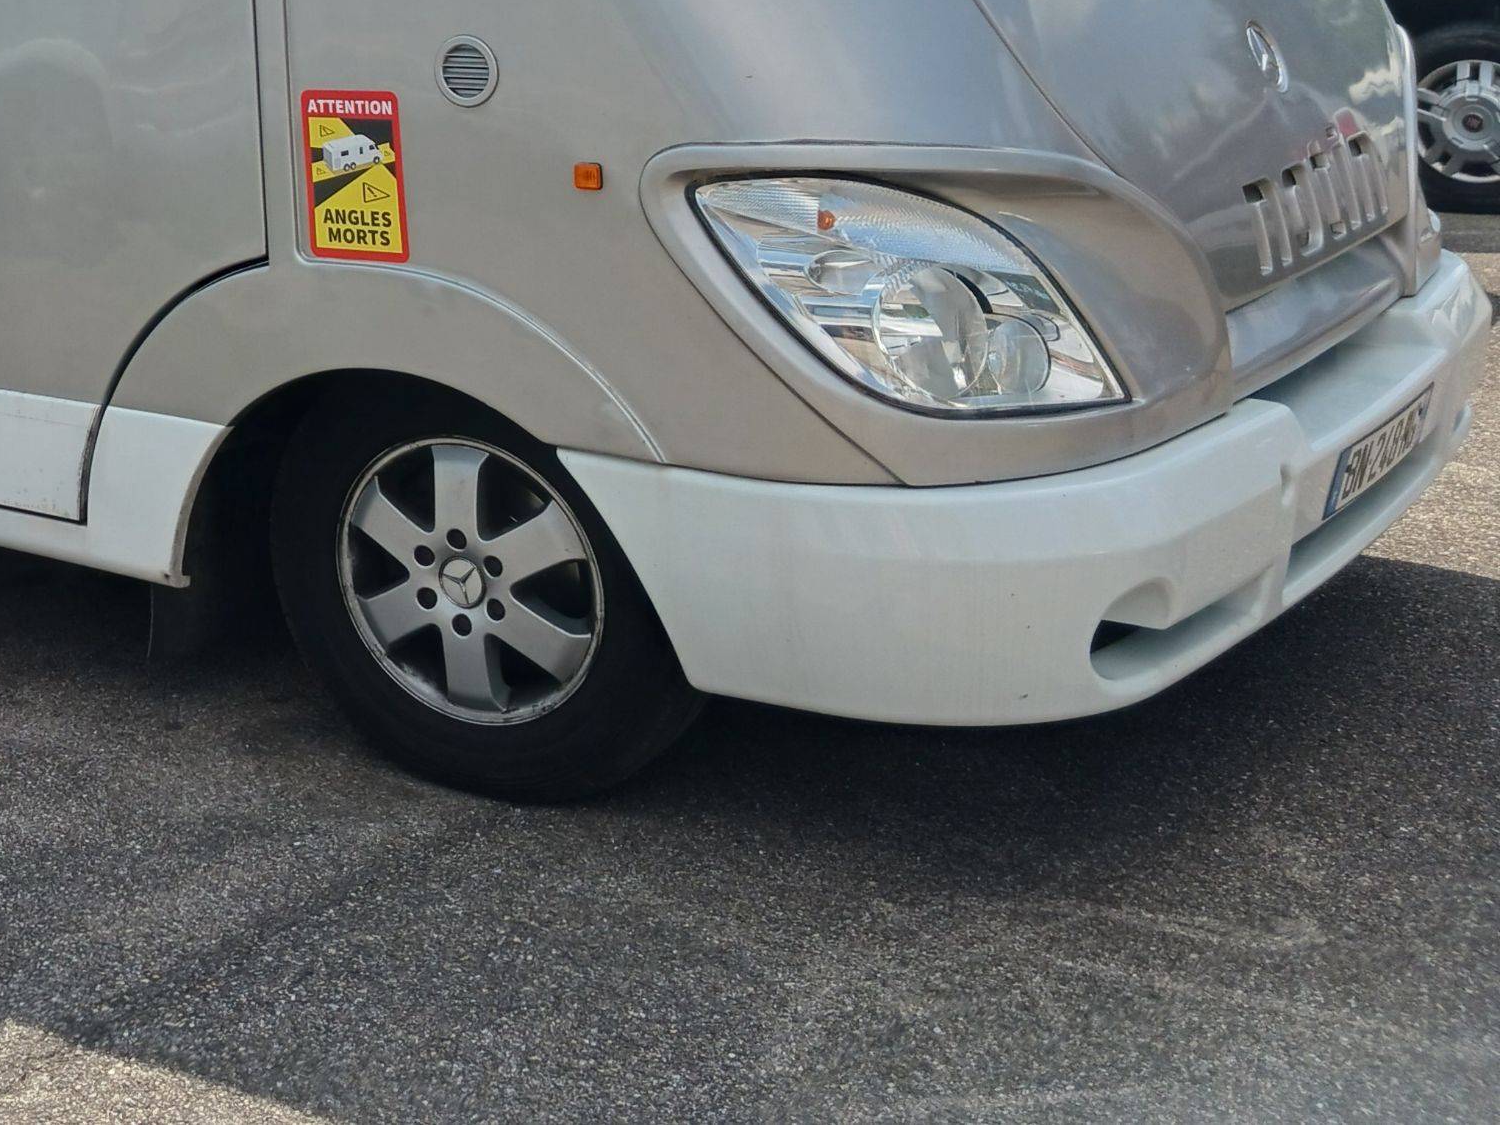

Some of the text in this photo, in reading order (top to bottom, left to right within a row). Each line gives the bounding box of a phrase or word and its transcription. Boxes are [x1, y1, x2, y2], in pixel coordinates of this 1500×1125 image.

[307, 98, 393, 116] ATTENTION
[323, 208, 392, 228] ANGLES
[327, 226, 391, 246] MORTS
